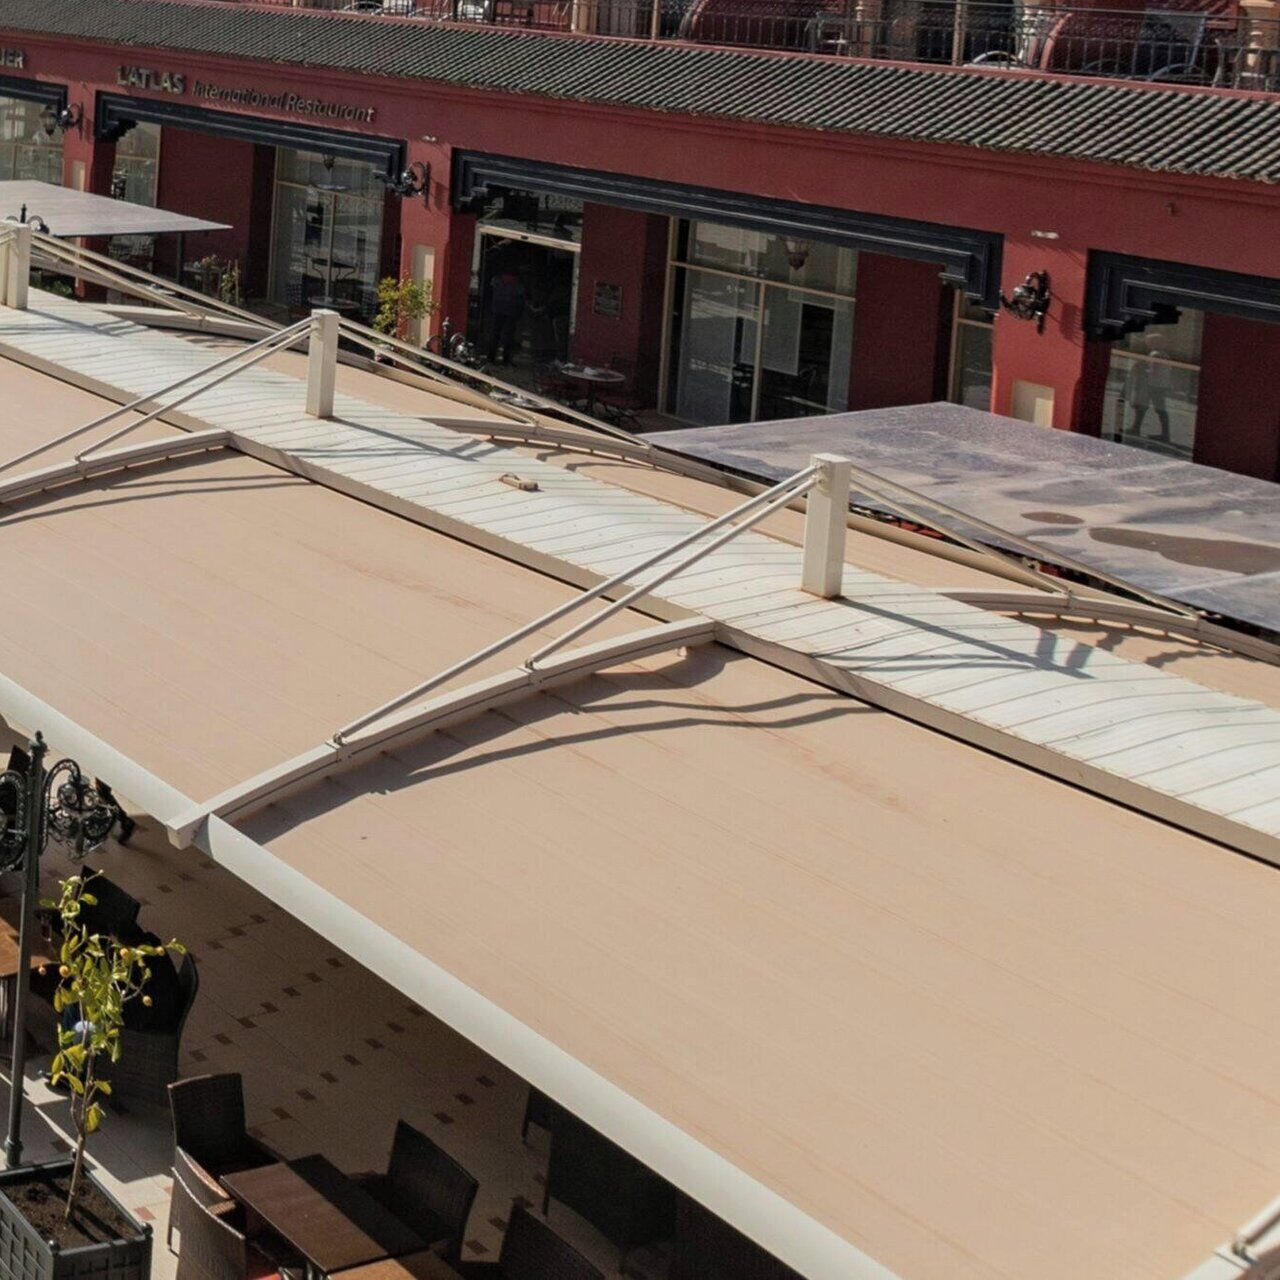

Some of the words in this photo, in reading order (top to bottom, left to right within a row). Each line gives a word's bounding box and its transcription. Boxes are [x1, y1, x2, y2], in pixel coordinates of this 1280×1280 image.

[116, 65, 184, 95] L'ATLAS
[192, 81, 284, 110] International
[286, 93, 375, 122] Restaurant
